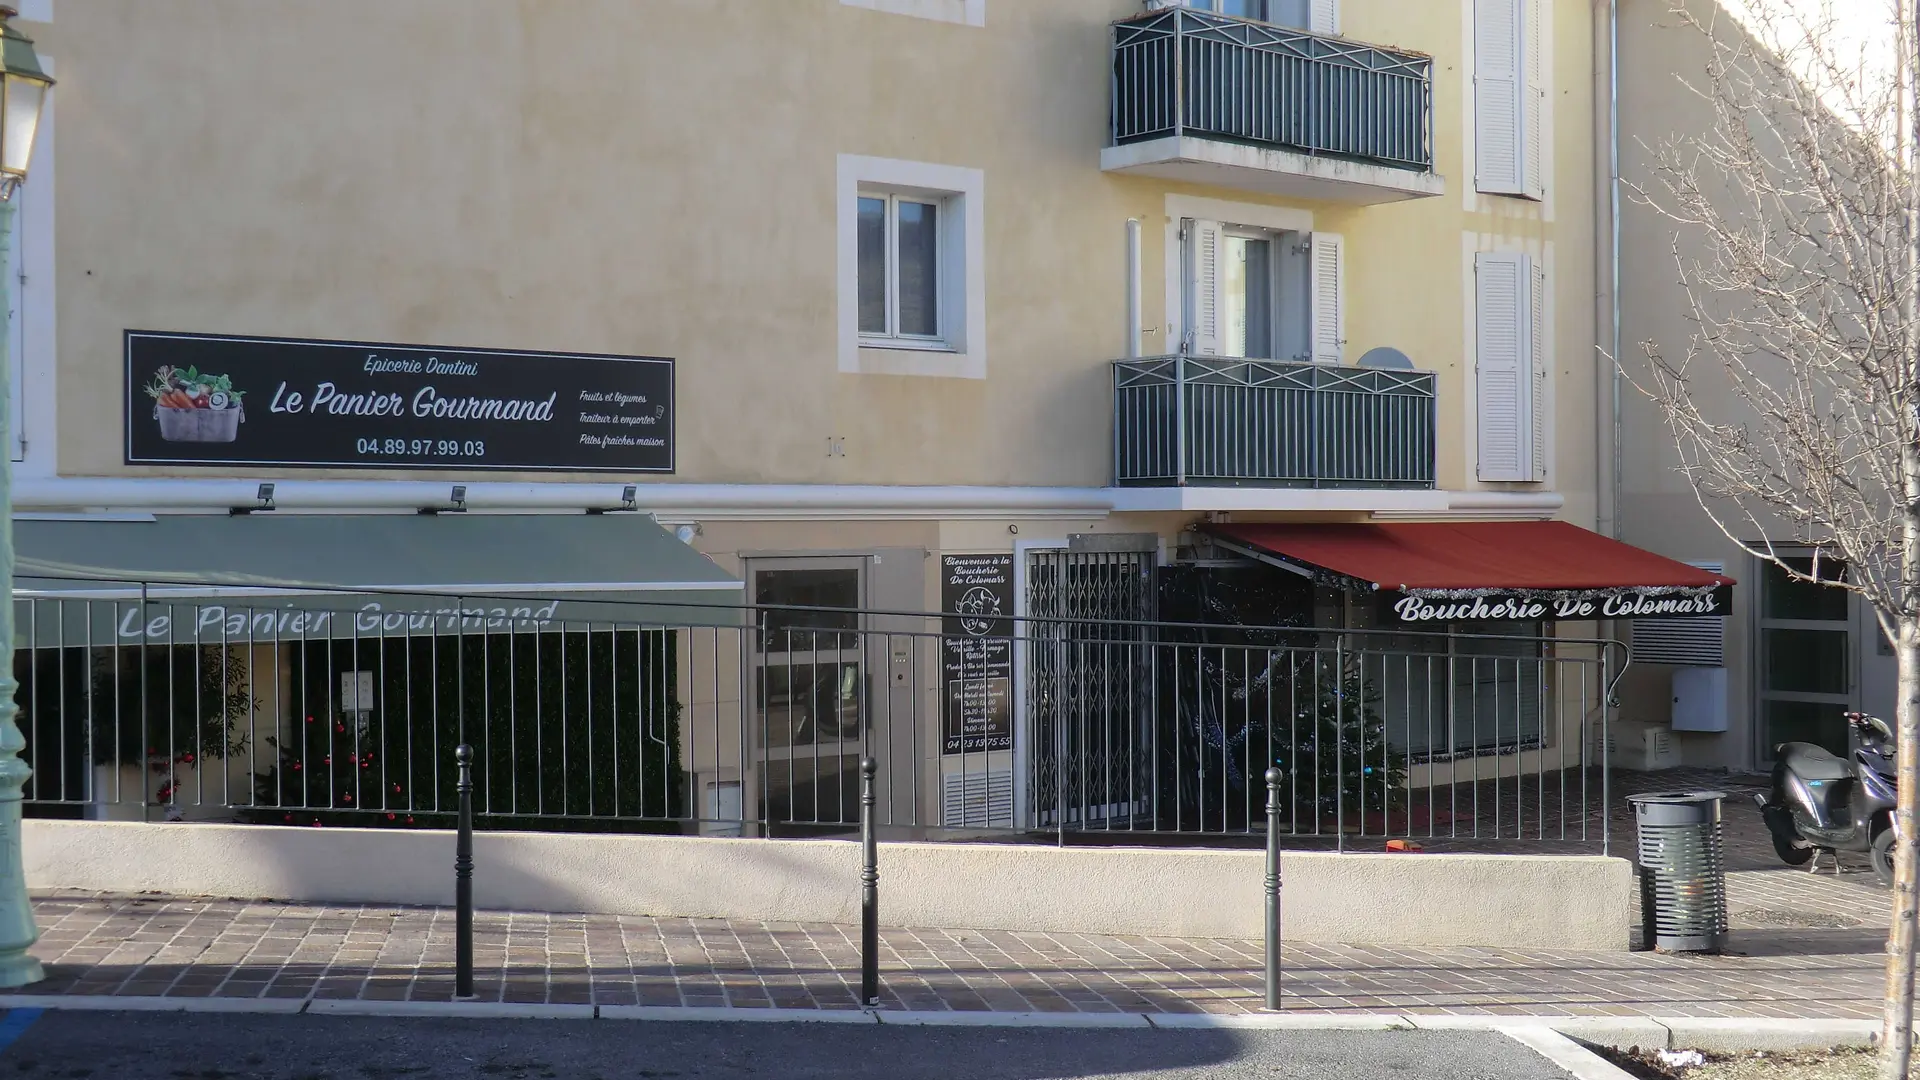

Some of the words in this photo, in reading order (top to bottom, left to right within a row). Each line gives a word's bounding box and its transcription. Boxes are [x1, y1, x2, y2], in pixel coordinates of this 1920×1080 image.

[363, 354, 422, 376] Epicerie
[426, 357, 478, 376] Dantini
[270, 381, 303, 413] Le
[310, 382, 404, 416] Panier
[412, 386, 557, 421] Gourmand
[580, 390, 604, 402] Fruits
[605, 392, 613, 402] et
[614, 392, 647, 407] légumes
[580, 412, 611, 424] Traiteur
[612, 414, 619, 424] à
[620, 415, 656, 426] emporter
[357, 438, 485, 456] 04.89.97.99.03
[580, 433, 601, 445] Pâtes
[636, 437, 665, 447] maison
[945, 556, 991, 566] Bienvenue
[992, 557, 999, 565] à
[1000, 556, 1010, 565] la
[954, 565, 999, 575] Boucherie
[950, 575, 964, 585] De
[965, 575, 1006, 584] Colomars
[1394, 596, 1547, 621] Boucherie
[1553, 599, 1596, 617] De
[1603, 593, 1719, 616] Colomars
[118, 608, 169, 637] Le
[194, 603, 335, 636] Panier
[356, 601, 559, 631] Gourmand
[947, 740, 960, 749] 04
[987, 737, 999, 746] 75
[999, 736, 1011, 746] 55
